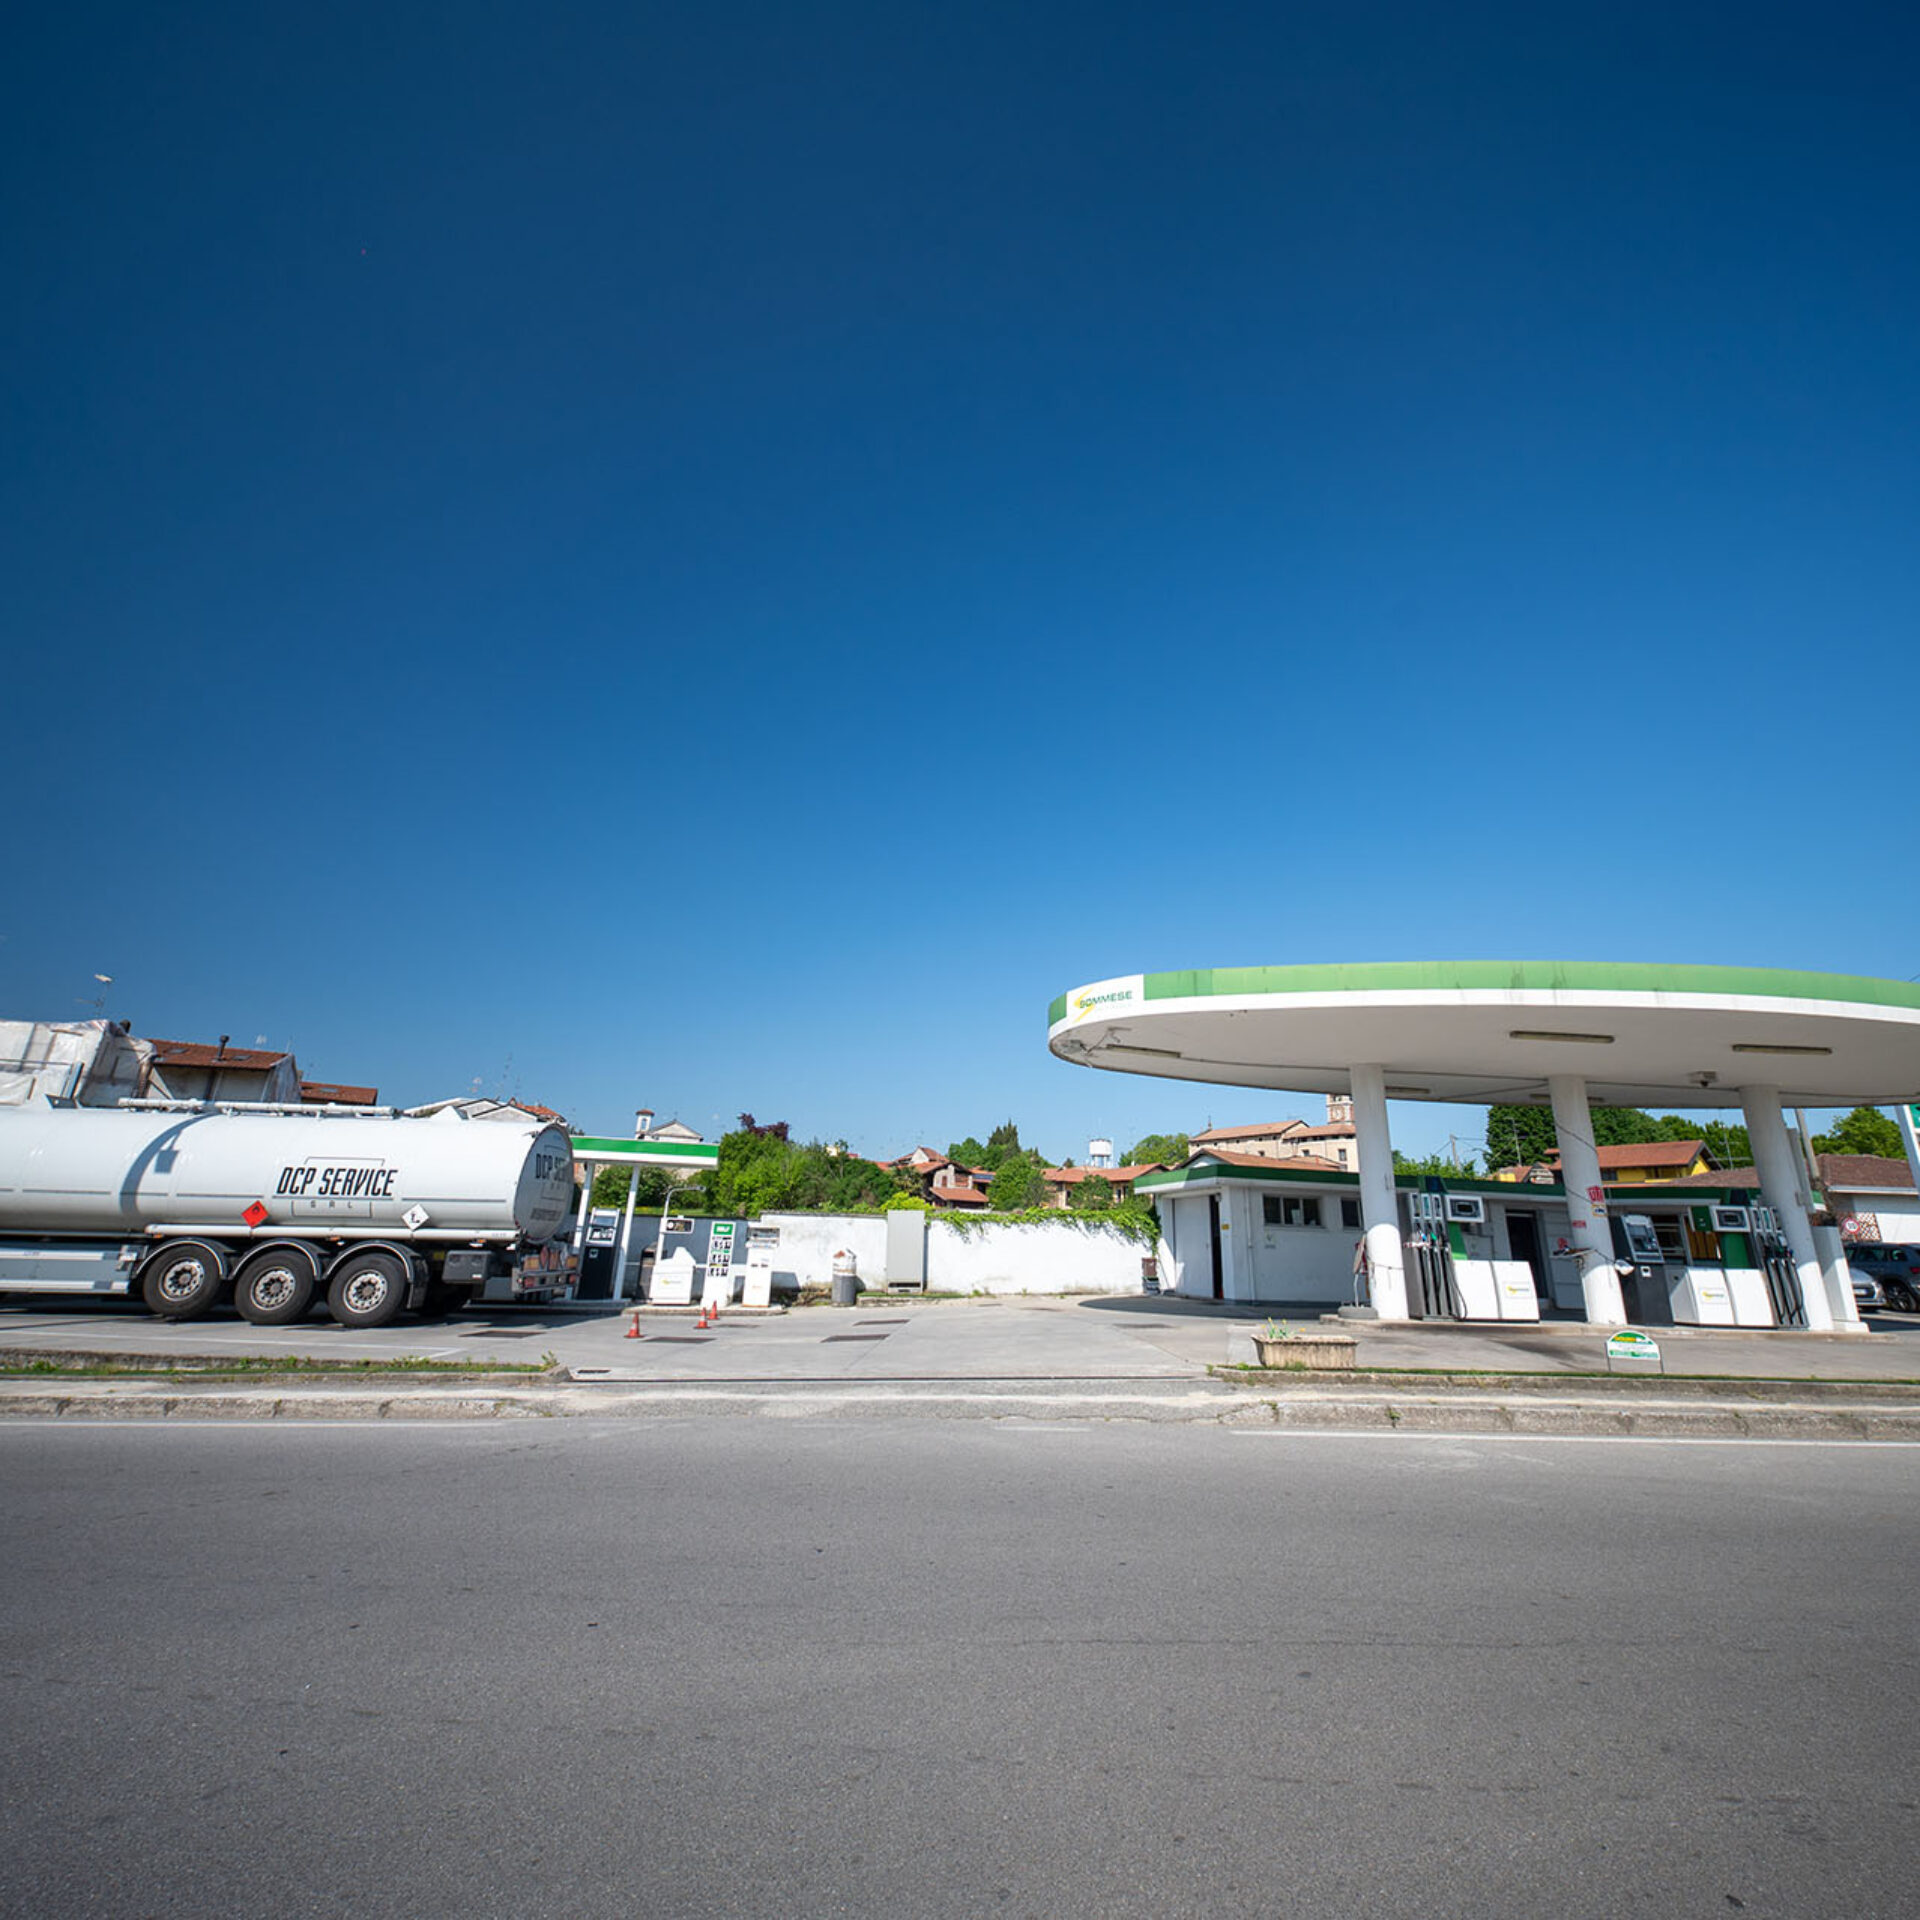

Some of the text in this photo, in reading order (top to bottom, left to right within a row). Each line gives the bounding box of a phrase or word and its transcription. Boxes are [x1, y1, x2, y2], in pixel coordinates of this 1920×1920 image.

[1079, 991, 1133, 1008] SOMMESE
[276, 1167, 398, 1196] DCP SERVICE
